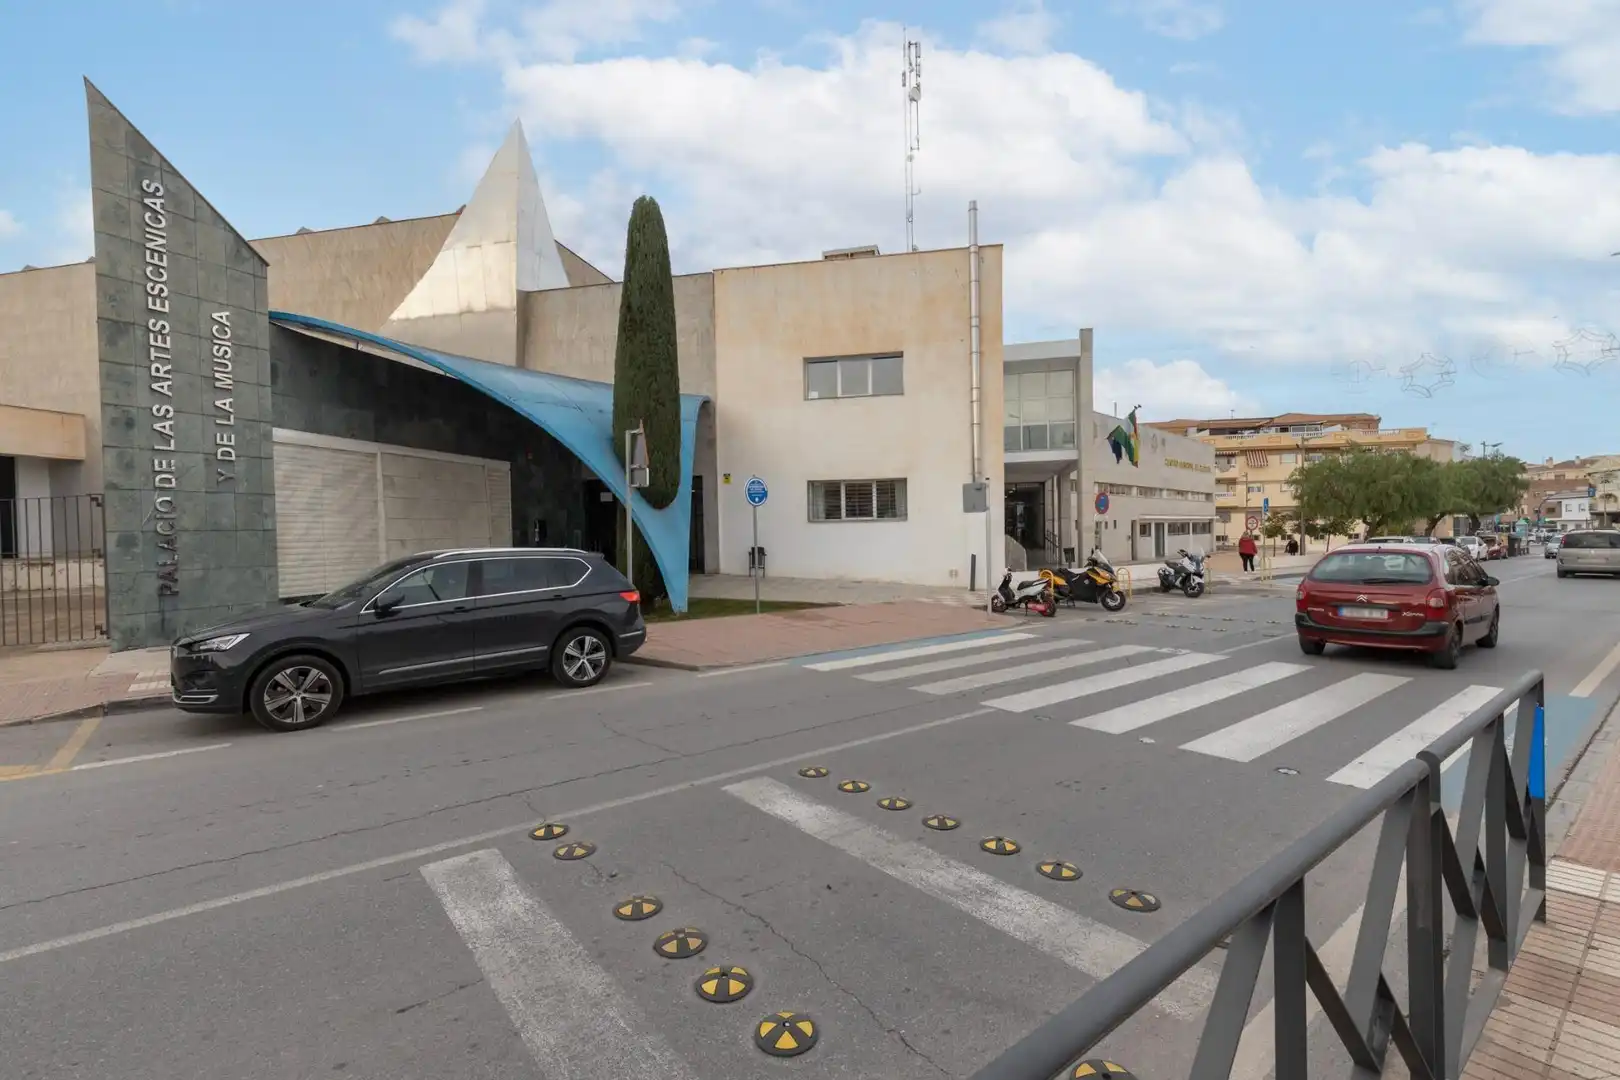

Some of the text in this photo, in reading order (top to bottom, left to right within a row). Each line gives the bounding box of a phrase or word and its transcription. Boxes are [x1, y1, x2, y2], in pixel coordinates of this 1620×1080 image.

[142, 179, 179, 597] PALACIO DE LAS ARTES ESCENICAS
[211, 311, 236, 486] Y DE LA MUSICA
